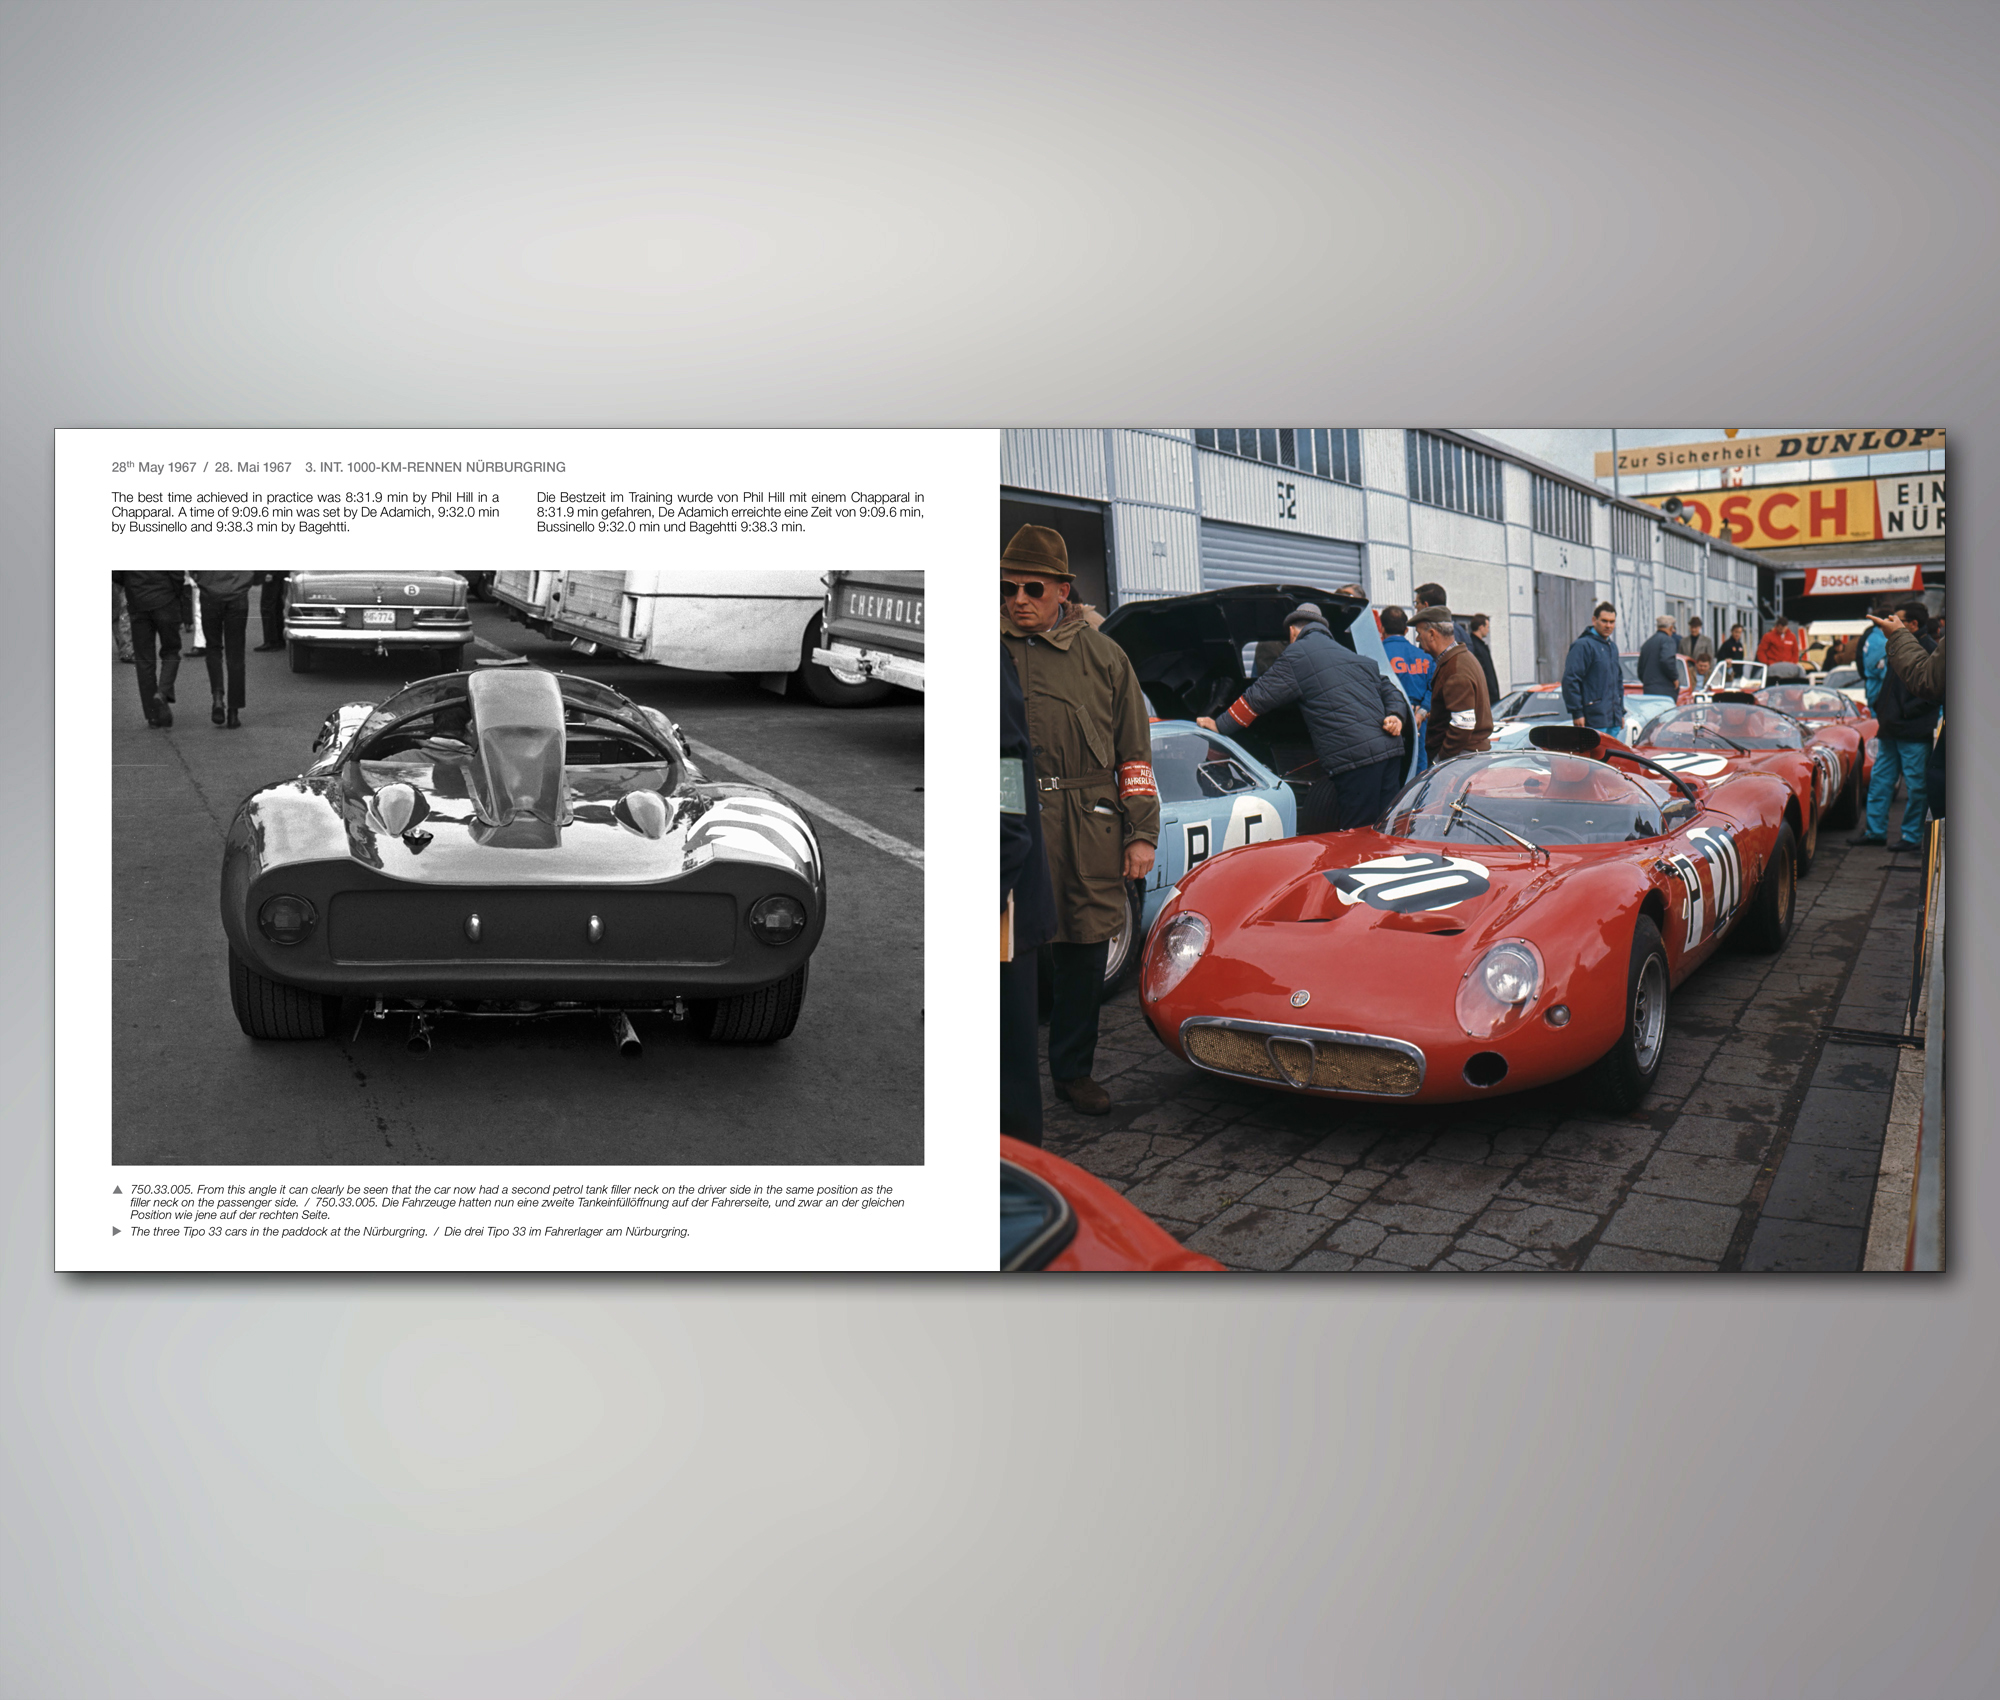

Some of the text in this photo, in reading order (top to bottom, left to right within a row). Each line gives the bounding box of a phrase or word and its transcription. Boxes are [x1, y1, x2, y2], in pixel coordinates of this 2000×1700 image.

[1618, 456, 1648, 469] Zur
[1656, 444, 1761, 466] Sicherheit
[111, 460, 135, 473] 28th
[138, 461, 165, 476] May
[168, 461, 197, 473] 1967
[214, 461, 233, 473] 28.
[237, 461, 260, 473] Mai
[263, 461, 292, 473] 1967
[305, 461, 316, 473] 3.
[320, 461, 344, 473] INT.
[347, 461, 462, 473] 1000-KM-RENNEN
[466, 459, 566, 473] NÜRBURGRING
[111, 491, 500, 506] The best time achieved in practice was 8:31.9 min by Phil Hill in a
[537, 491, 925, 506] Die Bestzeit im Training wurde von Phil Hill mit einem Chapparal in
[111, 505, 500, 520] Chapparal. A time of 9:09.6 min was set by De Adamich, 9:32.0 min
[536, 506, 924, 521] 8:31.9 min gefahren, De Adamich erreichte eine Zeit von 9:09.6 min,
[111, 520, 350, 536] by Bussinello and 9:38.3 min by Bagehtti.
[537, 520, 806, 535] Bussinello 9:32.0 min und Bagehtti 9:38.3 min.
[1820, 574, 1859, 587] BOSCH
[850, 593, 923, 625] CHEVROLE
[1390, 656, 1430, 675] Gulf
[1322, 852, 1490, 914] 20
[131, 1184, 894, 1197] 750.33.005. From this angle it can clearly be seen that the car now had a second petrol tank filler neck on the driver side in the same position as the
[130, 1197, 152, 1208] filler
[152, 1197, 180, 1208] neck
[180, 1199, 195, 1208] on
[197, 1197, 215, 1208] the
[216, 1199, 273, 1210] passenger
[274, 1197, 299, 1208] side.
[315, 1196, 378, 1208] 750.33.005.
[381, 1196, 400, 1208] Die
[401, 1196, 457, 1210] Fahrzeuge
[458, 1197, 492, 1208] hatten
[493, 1199, 515, 1208] nun
[516, 1197, 540, 1208] eine
[540, 1197, 575, 1208] zweite
[577, 1196, 670, 1210] Tankeinfüllöffnung
[671, 1196, 690, 1208] auf
[690, 1197, 710, 1208] der
[711, 1196, 771, 1209] Fahrerseite,
[774, 1197, 797, 1208] und
[797, 1199, 824, 1208] zwar
[825, 1199, 839, 1208] an
[841, 1197, 860, 1208] der
[861, 1197, 905, 1210] gleichen
